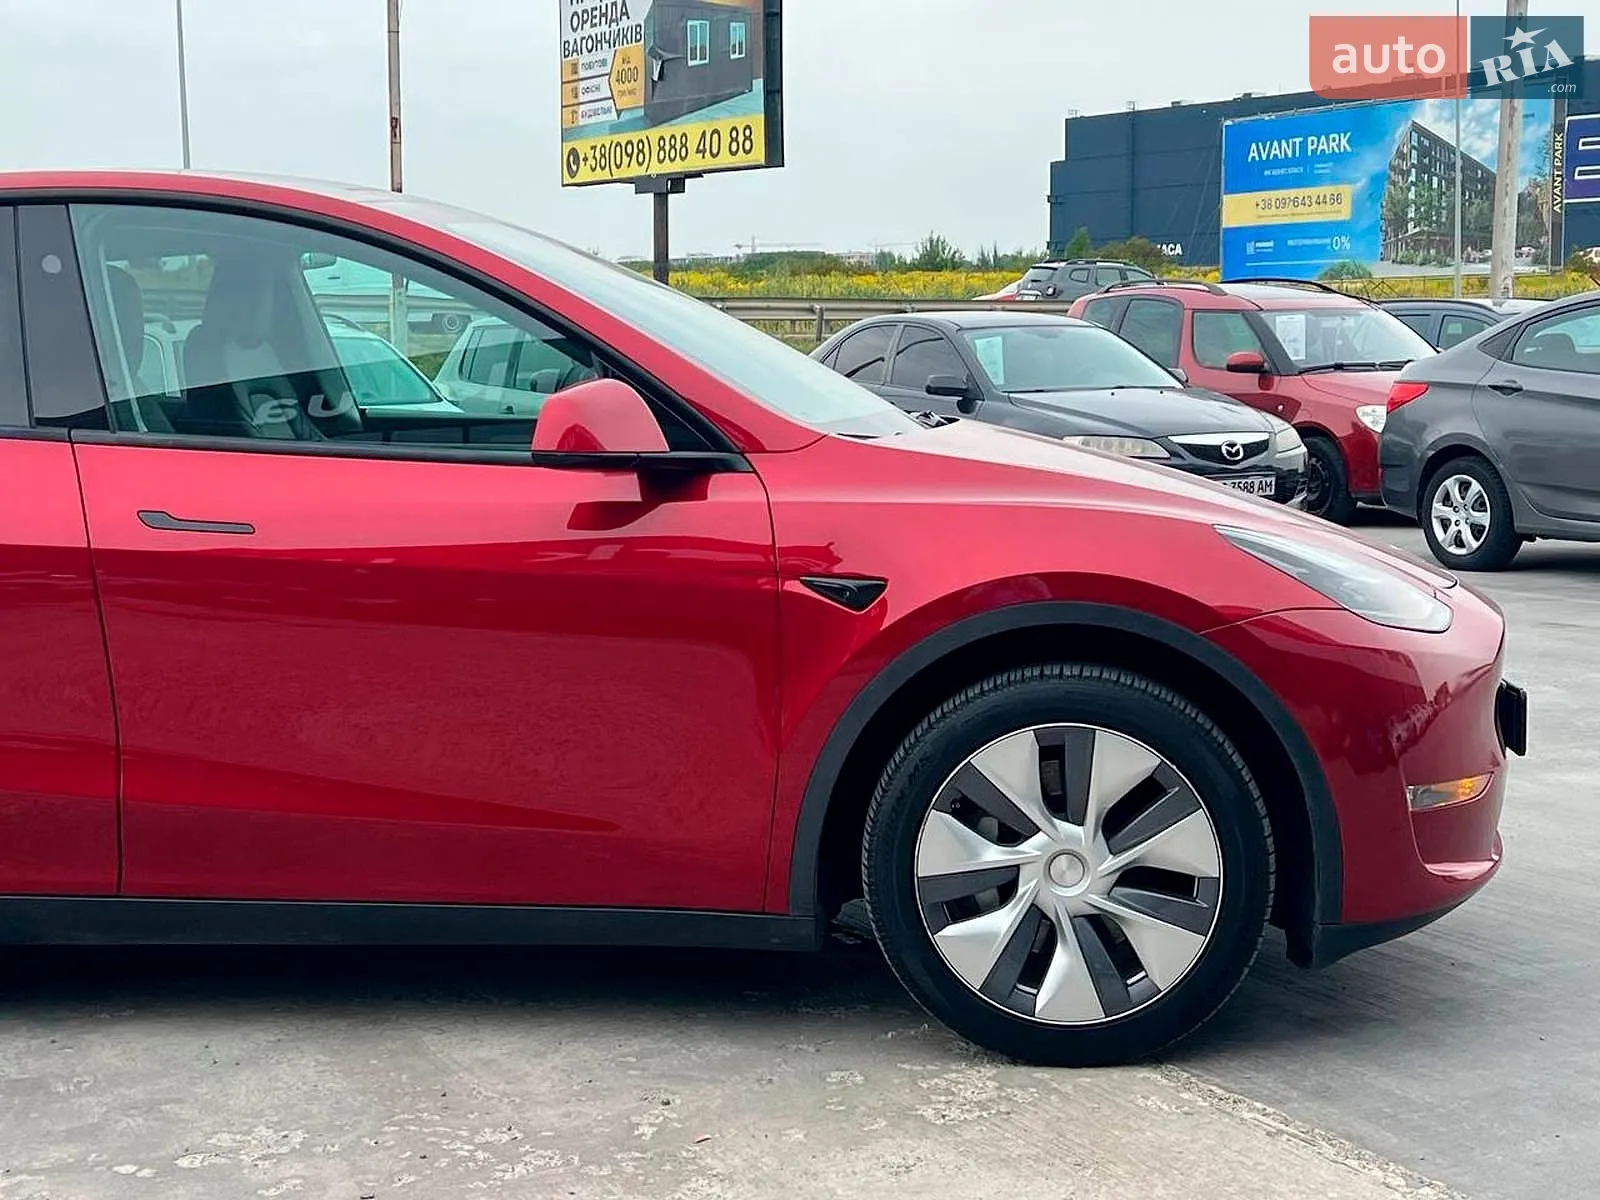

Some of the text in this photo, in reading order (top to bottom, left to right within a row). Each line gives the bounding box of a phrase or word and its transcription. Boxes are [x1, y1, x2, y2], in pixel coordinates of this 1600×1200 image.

[570, 0, 630, 33] ОРЕНДА
[563, 23, 642, 59] ВАГОНЧИКІВ
[615, 65, 639, 85] 4000
[582, 124, 754, 177] +38(098) 888 40 88
[1247, 131, 1352, 162] AVANT PARK
[1553, 132, 1563, 213] AVANT PARK
[1157, 243, 1183, 256] АСА
[1332, 235, 1351, 251] 0%
[1257, 479, 1273, 493] AM
